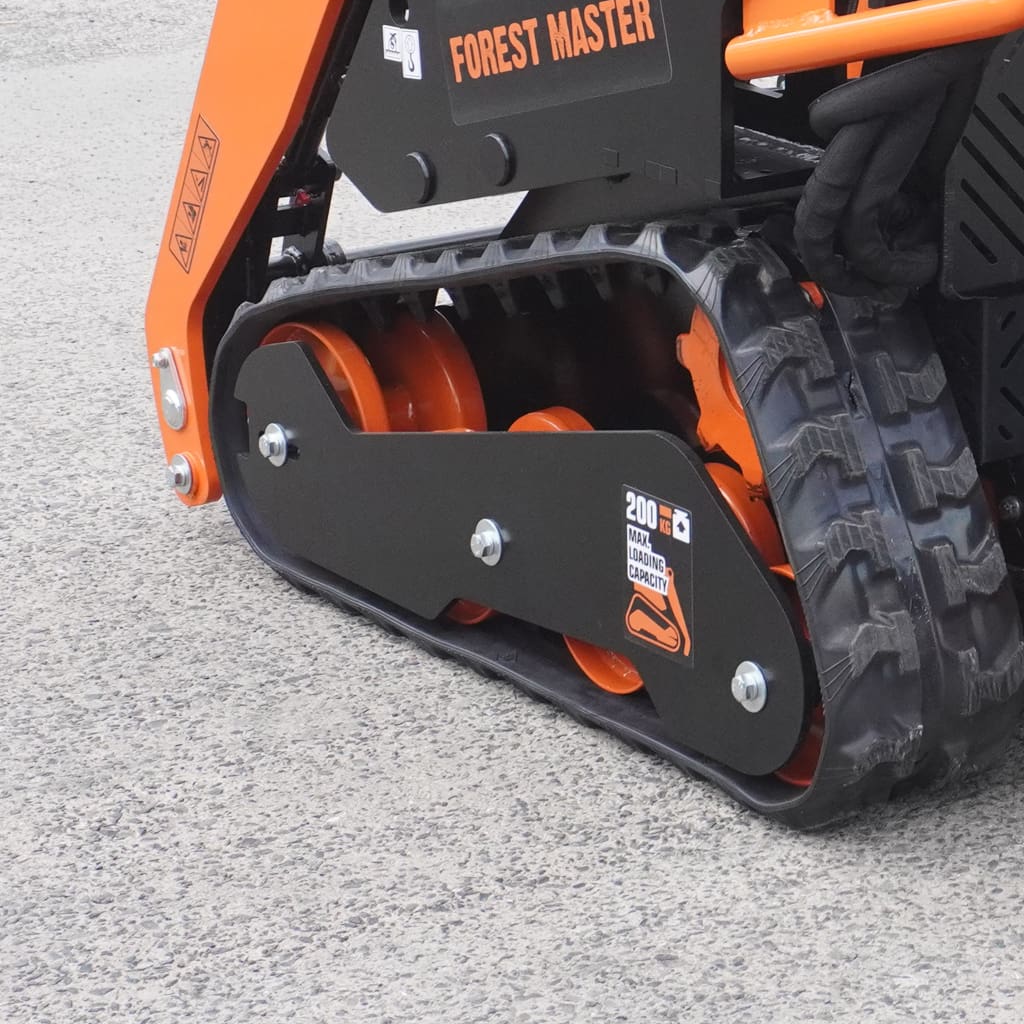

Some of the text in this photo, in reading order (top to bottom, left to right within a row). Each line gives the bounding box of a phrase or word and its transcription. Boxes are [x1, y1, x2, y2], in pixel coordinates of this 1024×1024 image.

[449, 17, 540, 83] FOREST
[625, 491, 658, 530] 200
[628, 527, 651, 549] MAX.
[658, 517, 672, 536] KG
[628, 547, 665, 573] LOADING
[629, 565, 668, 594] CAPACITY
